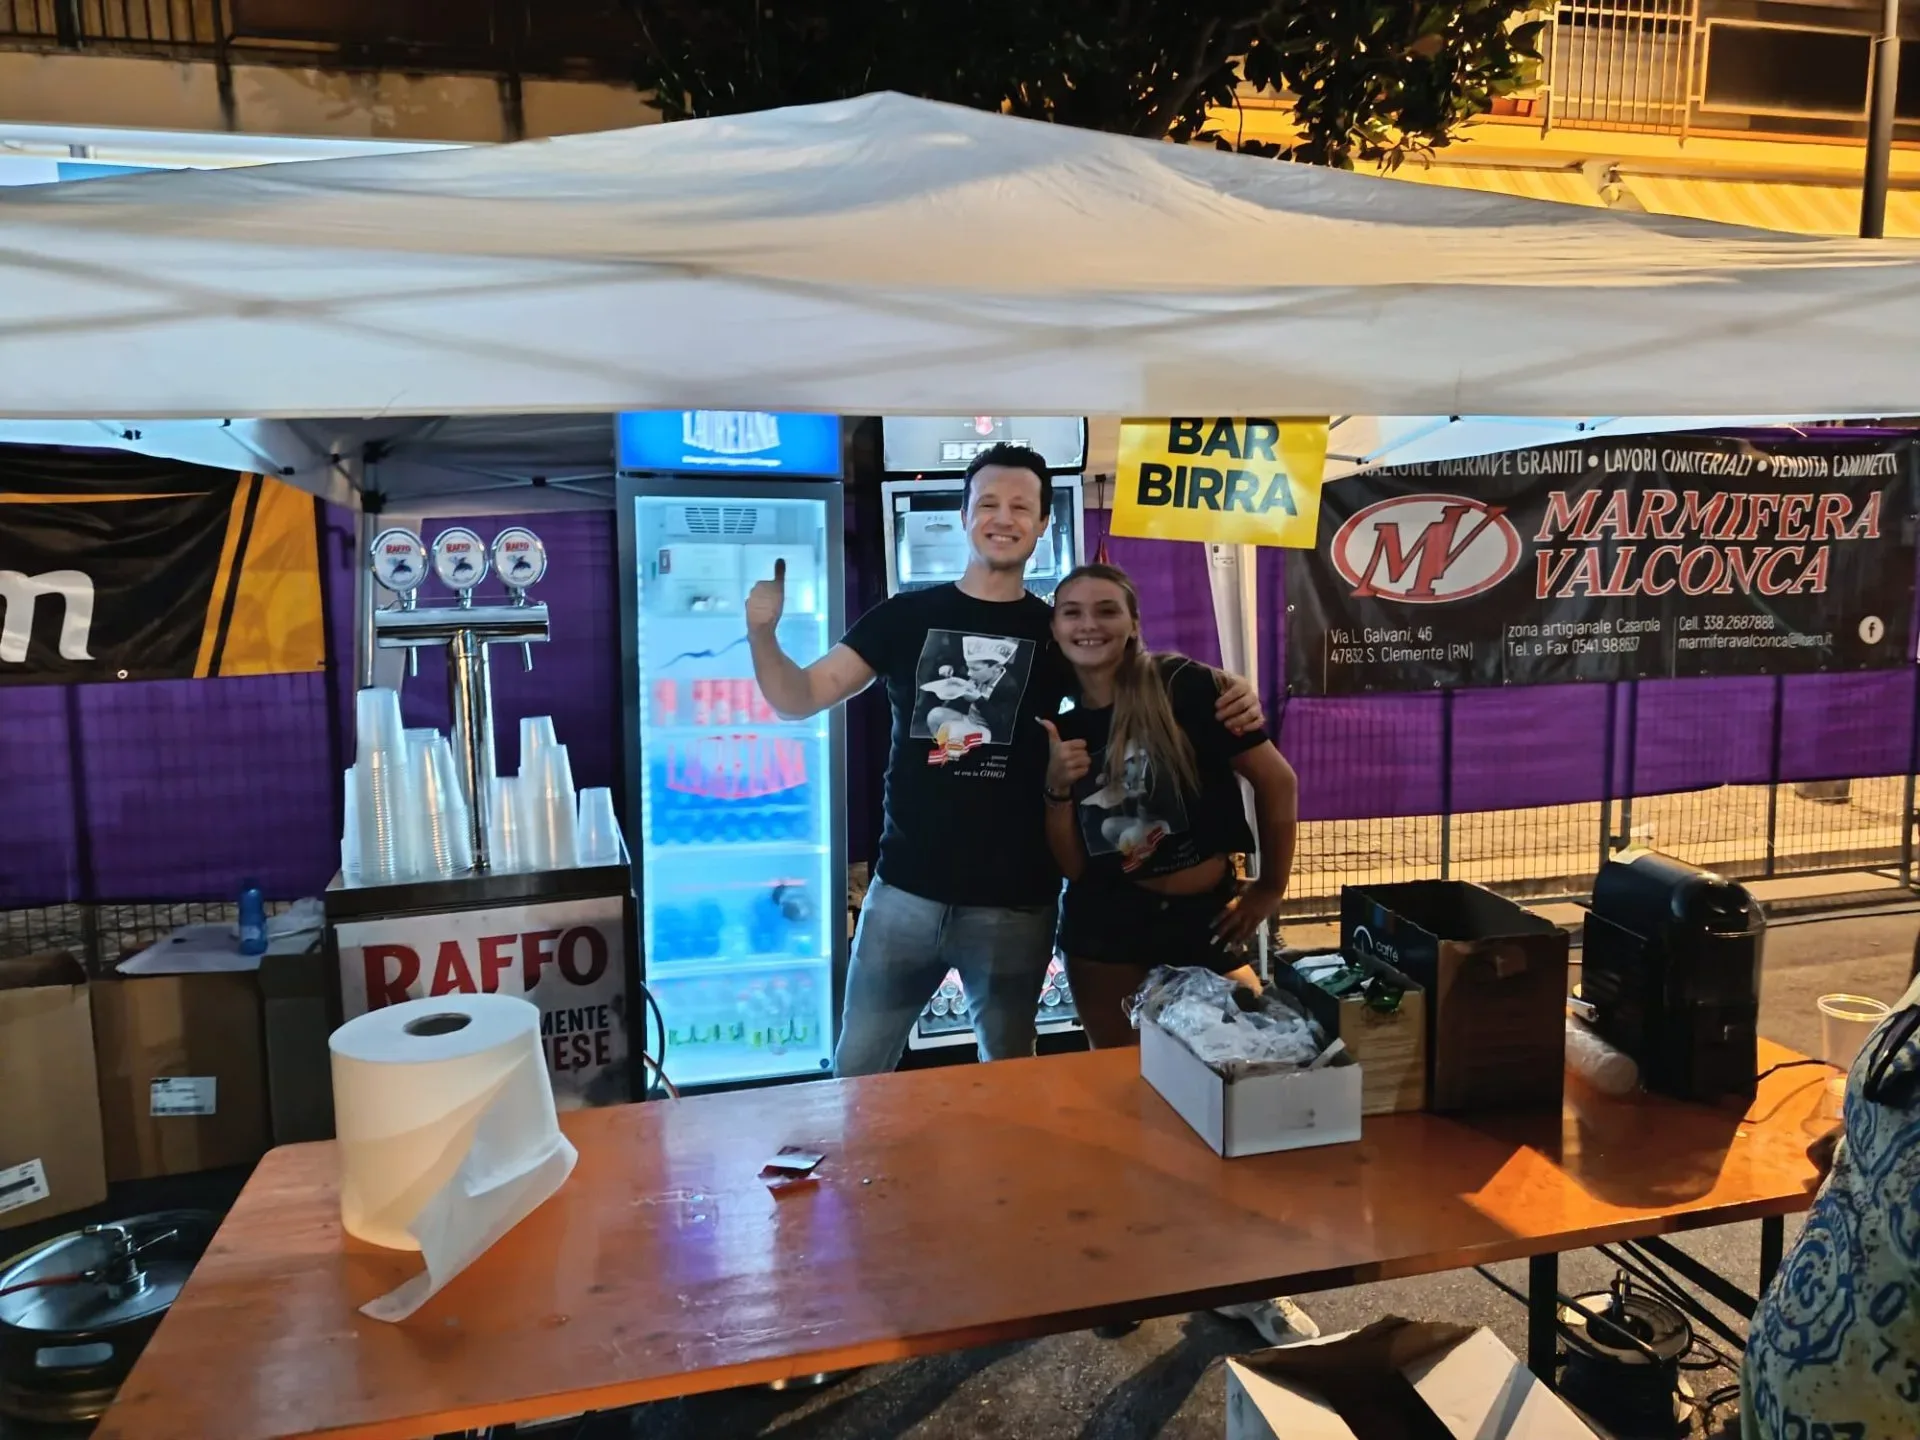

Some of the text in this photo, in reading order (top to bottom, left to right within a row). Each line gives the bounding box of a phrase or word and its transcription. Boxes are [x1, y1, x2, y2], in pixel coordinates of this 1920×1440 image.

[1168, 417, 1279, 461] BAR
[1517, 448, 1582, 475] GRANITI
[1604, 448, 1656, 473] LAVORI
[1769, 455, 1828, 478] VENDITA
[1833, 453, 1898, 478] CAMINETTI
[1137, 462, 1298, 516] BIRRA
[1533, 489, 1883, 542] MARMIFERA
[1535, 545, 1830, 599] VALCONCA
[1330, 628, 1349, 645] Via
[1364, 625, 1414, 644] Galvani,
[1417, 625, 1433, 642] 46
[1507, 624, 1538, 638] zona
[1542, 619, 1612, 639] artigianale
[1367, 646, 1379, 663] S.
[1381, 645, 1444, 663] Clemente
[1448, 641, 1474, 661] (RN)
[1508, 641, 1531, 657] Tel.
[1534, 643, 1543, 656] e
[1547, 639, 1568, 655] Fax
[361, 925, 609, 1011] RAFFO
